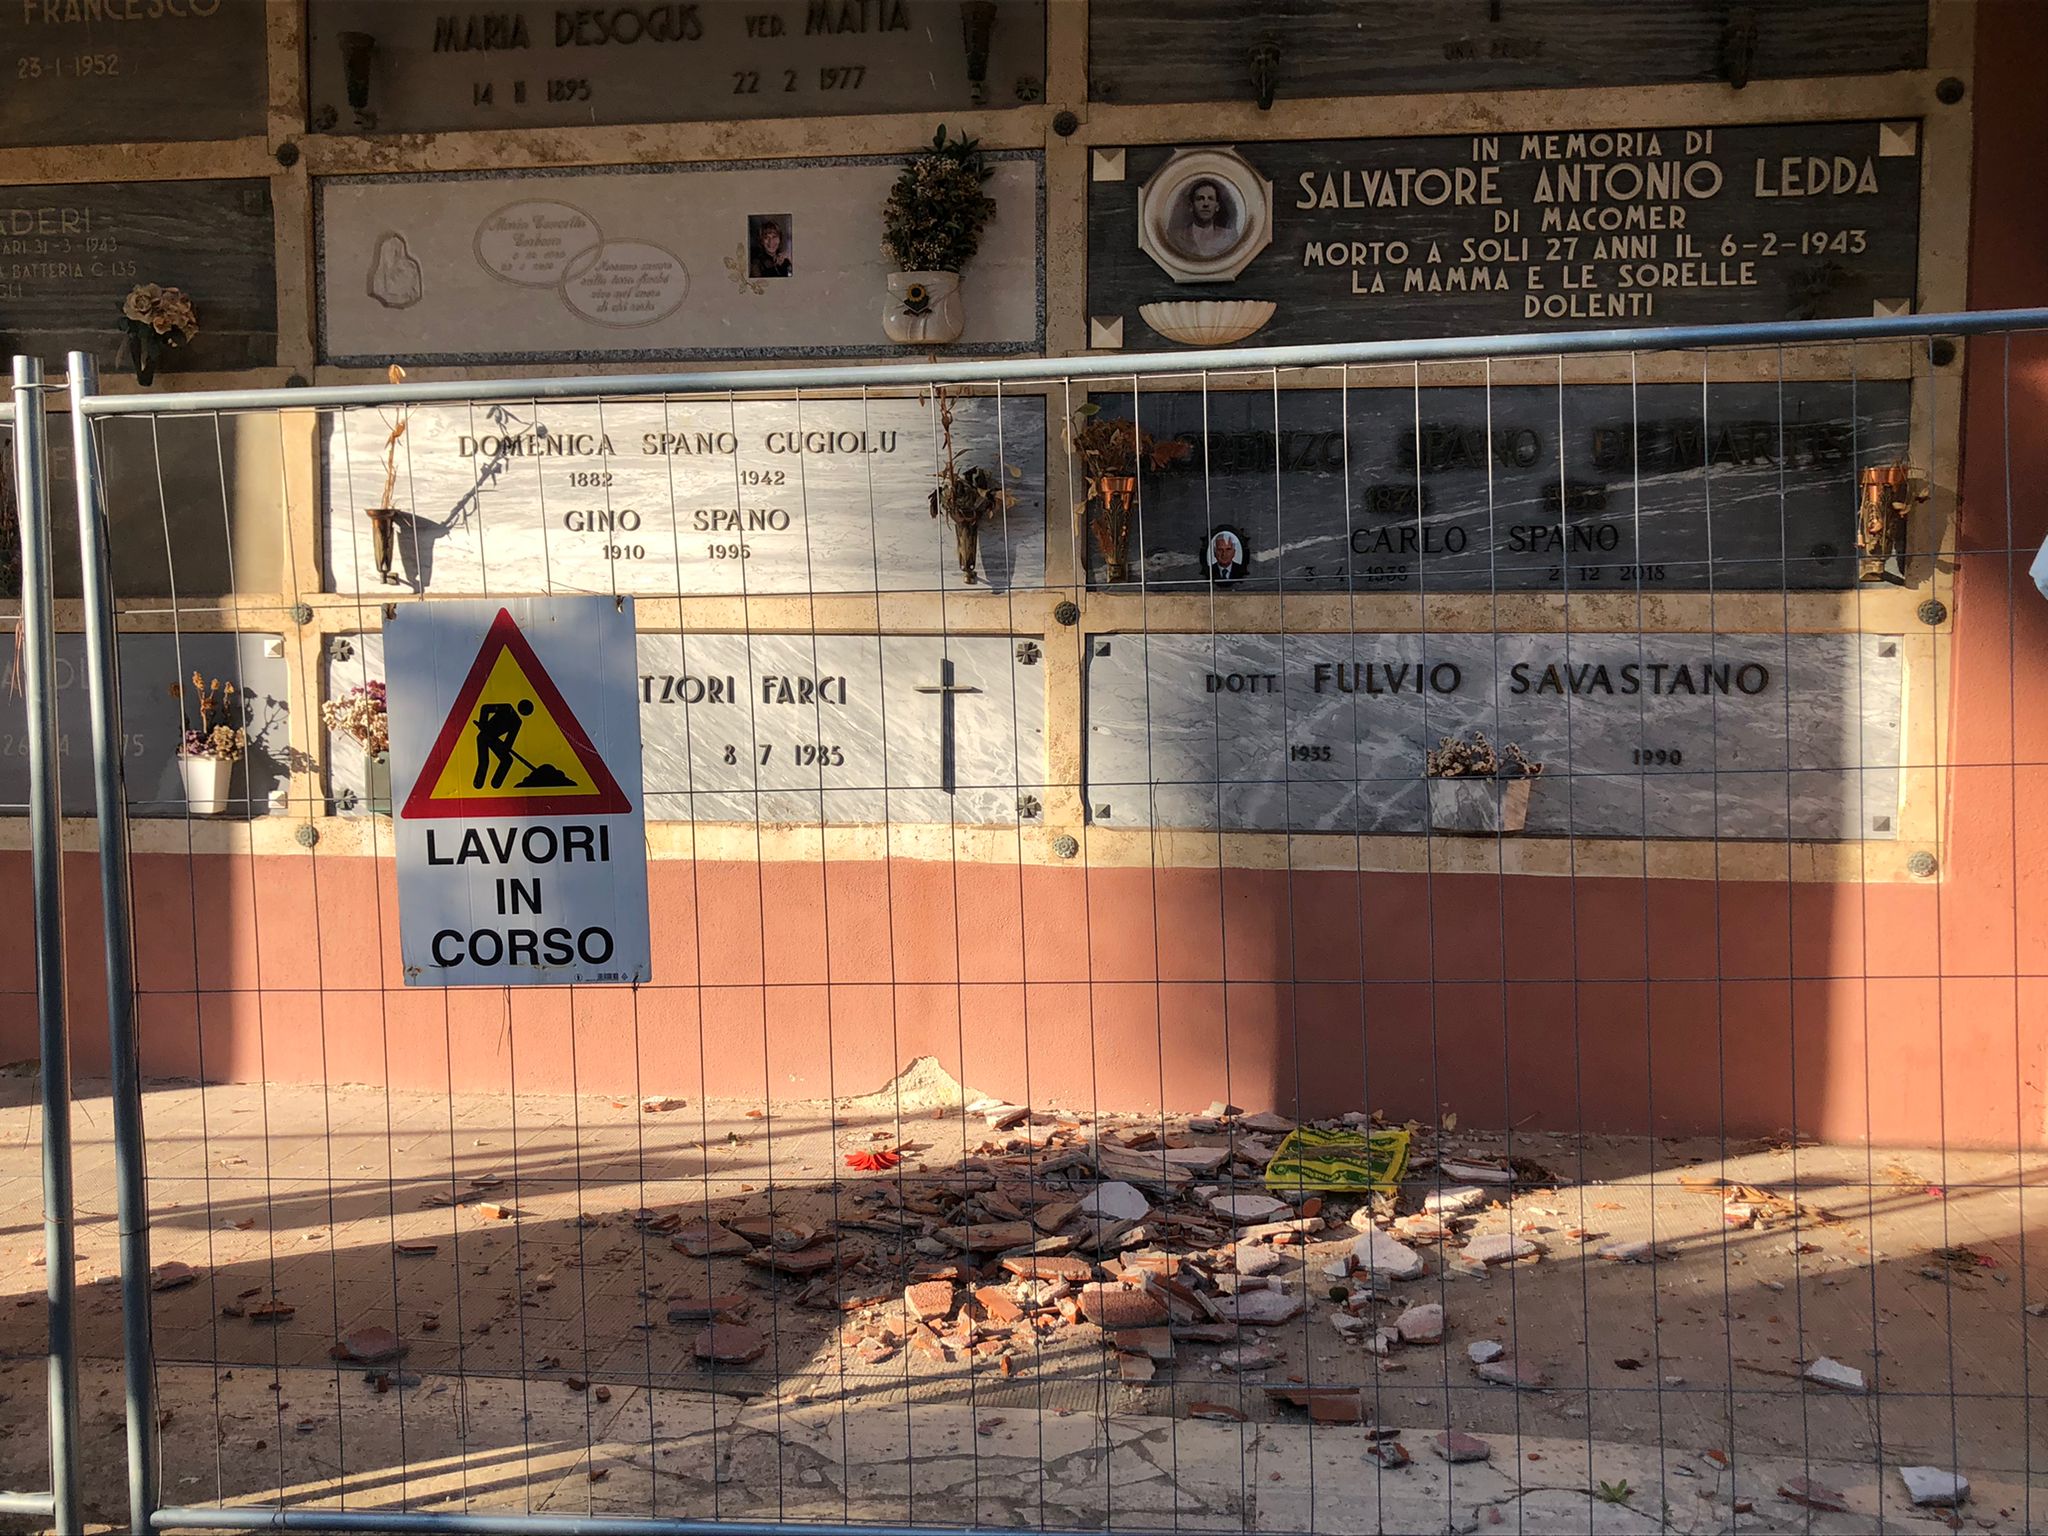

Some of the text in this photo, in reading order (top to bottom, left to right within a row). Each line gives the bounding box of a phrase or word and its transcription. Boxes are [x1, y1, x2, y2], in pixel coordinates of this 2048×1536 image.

[433, 13, 531, 53] MARIA
[473, 81, 494, 106] 14
[732, 65, 867, 94] 22 2 1977
[1472, 129, 1713, 162] IN MEMORIA DI
[1296, 156, 1879, 211] SALVATORE ANTONIO LEDDA
[0, 206, 91, 237] DERI
[1495, 205, 1686, 234] DI MACOMER
[1303, 230, 1868, 267] MORTO A SOLI 27 ANNI IL 6-2-1943
[1351, 261, 1758, 295] LA MAMMA E LE SORELLE
[1524, 292, 1654, 319] DOLENTI
[458, 430, 898, 458] DOMENICA SPANO CUGIOLU
[568, 470, 786, 488] 1882 1942
[563, 507, 791, 533] GINO SPANO
[602, 544, 646, 560] 1910
[1351, 525, 1620, 554] CARLO SPANO
[1549, 564, 1666, 581] 2 12 2018
[638, 674, 848, 705] TZORI FARCI
[1313, 662, 1463, 695] FULVIO
[1510, 661, 1770, 696] SAVASTANO
[723, 743, 846, 767] 8 7 1985
[1632, 747, 1682, 766] 1990
[426, 824, 609, 866] LAVORI
[495, 877, 543, 915] IN
[431, 926, 614, 968] CORSO
